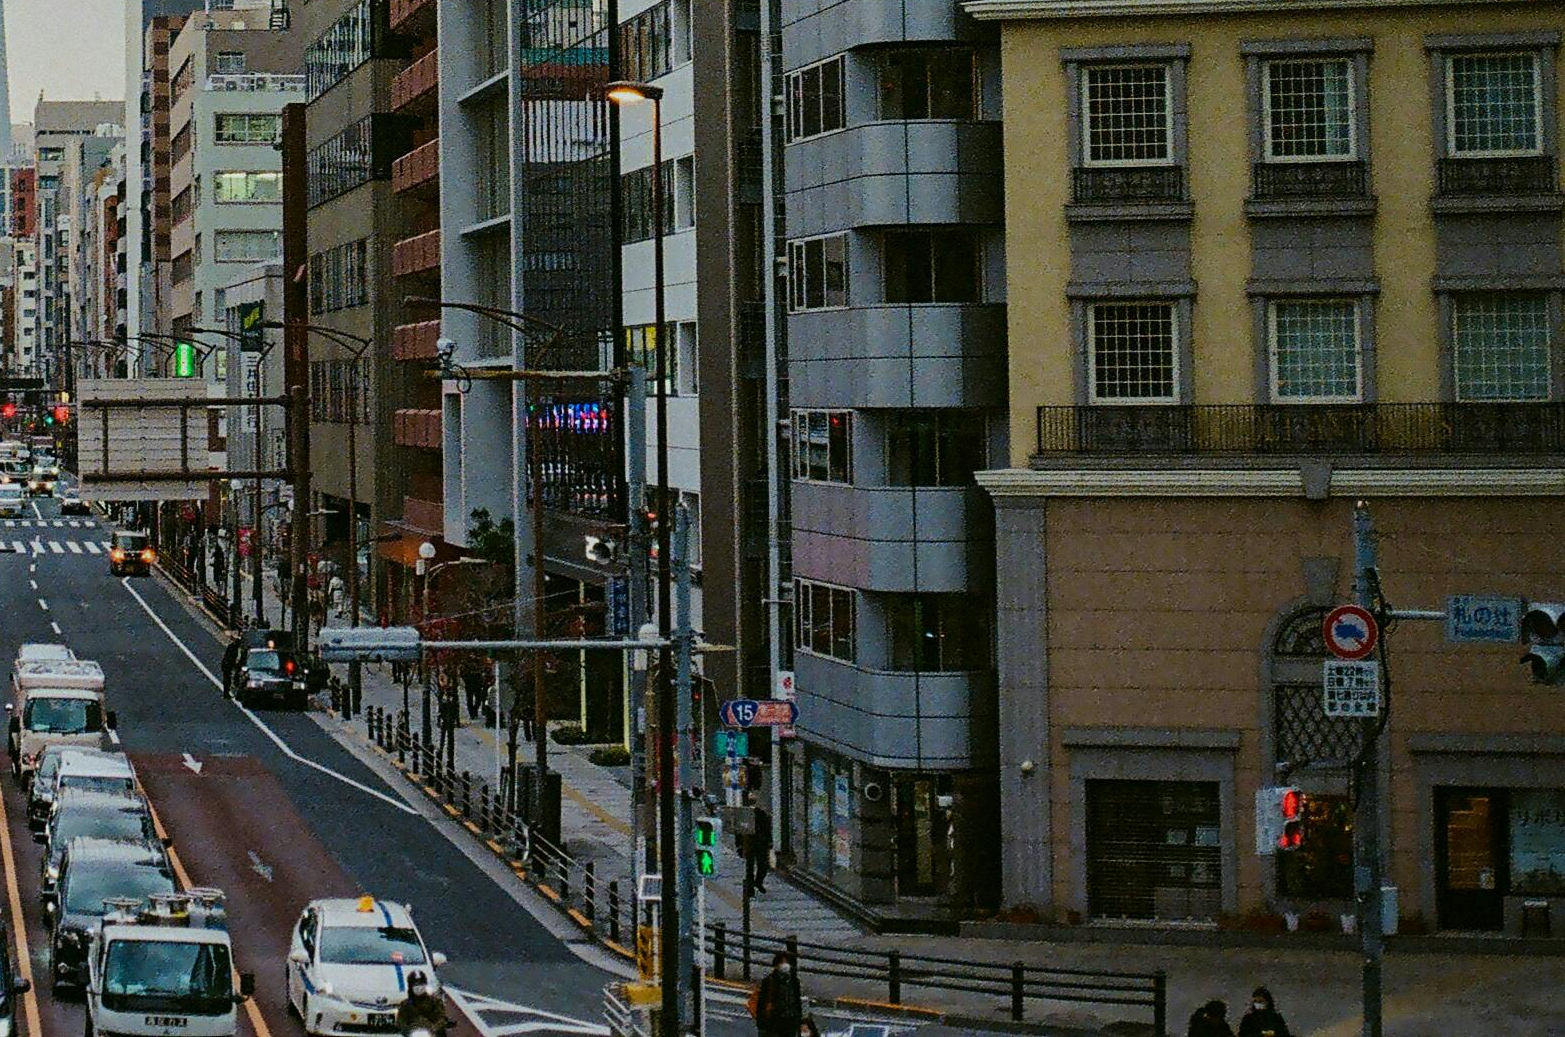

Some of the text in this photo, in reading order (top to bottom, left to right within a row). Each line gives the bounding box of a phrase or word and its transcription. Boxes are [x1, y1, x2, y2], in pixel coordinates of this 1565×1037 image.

[1454, 606, 1513, 626] 札の辻
[737, 704, 754, 721] 15
